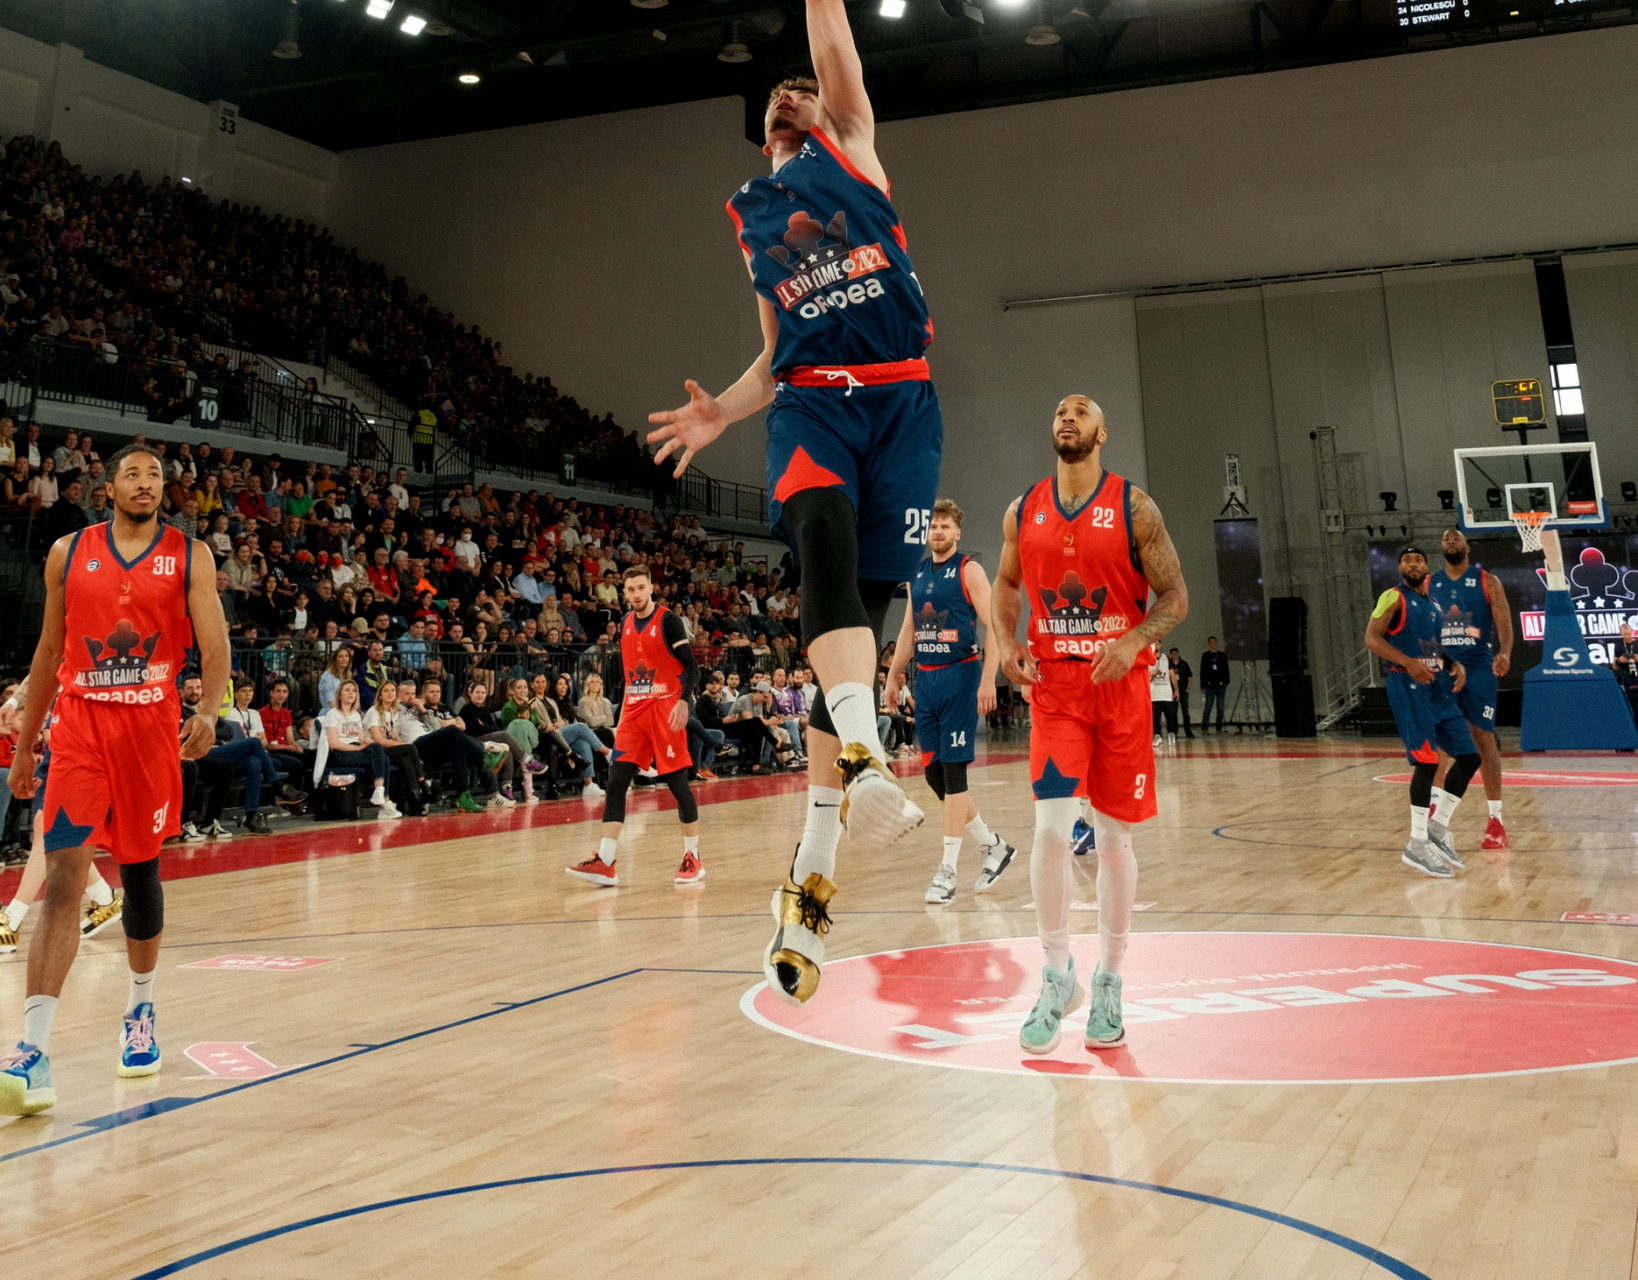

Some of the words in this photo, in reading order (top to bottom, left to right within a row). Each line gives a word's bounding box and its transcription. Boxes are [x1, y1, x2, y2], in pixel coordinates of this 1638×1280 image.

[1410, 0, 1456, 13] NICOLESCU
[1399, 18, 1410, 26] 30
[1412, 12, 1450, 25] STEWART
[1464, 10, 1470, 18] 0
[219, 116, 236, 135] 33
[198, 399, 219, 422] 10
[564, 463, 575, 480] 11
[904, 507, 931, 545] 25
[1092, 506, 1115, 529] 22
[152, 555, 176, 576] 30
[944, 568, 957, 579] 14
[1464, 578, 1476, 587] 33
[650, 624, 657, 638] 4
[1102, 615, 1127, 632] 2022
[1587, 613, 1626, 635] GAME
[88, 670, 112, 687] STAR
[112, 668, 142, 685] GAME
[150, 663, 170, 682] 2022
[1482, 706, 1494, 720] 33
[950, 730, 967, 748] 14
[666, 744, 676, 758] 4
